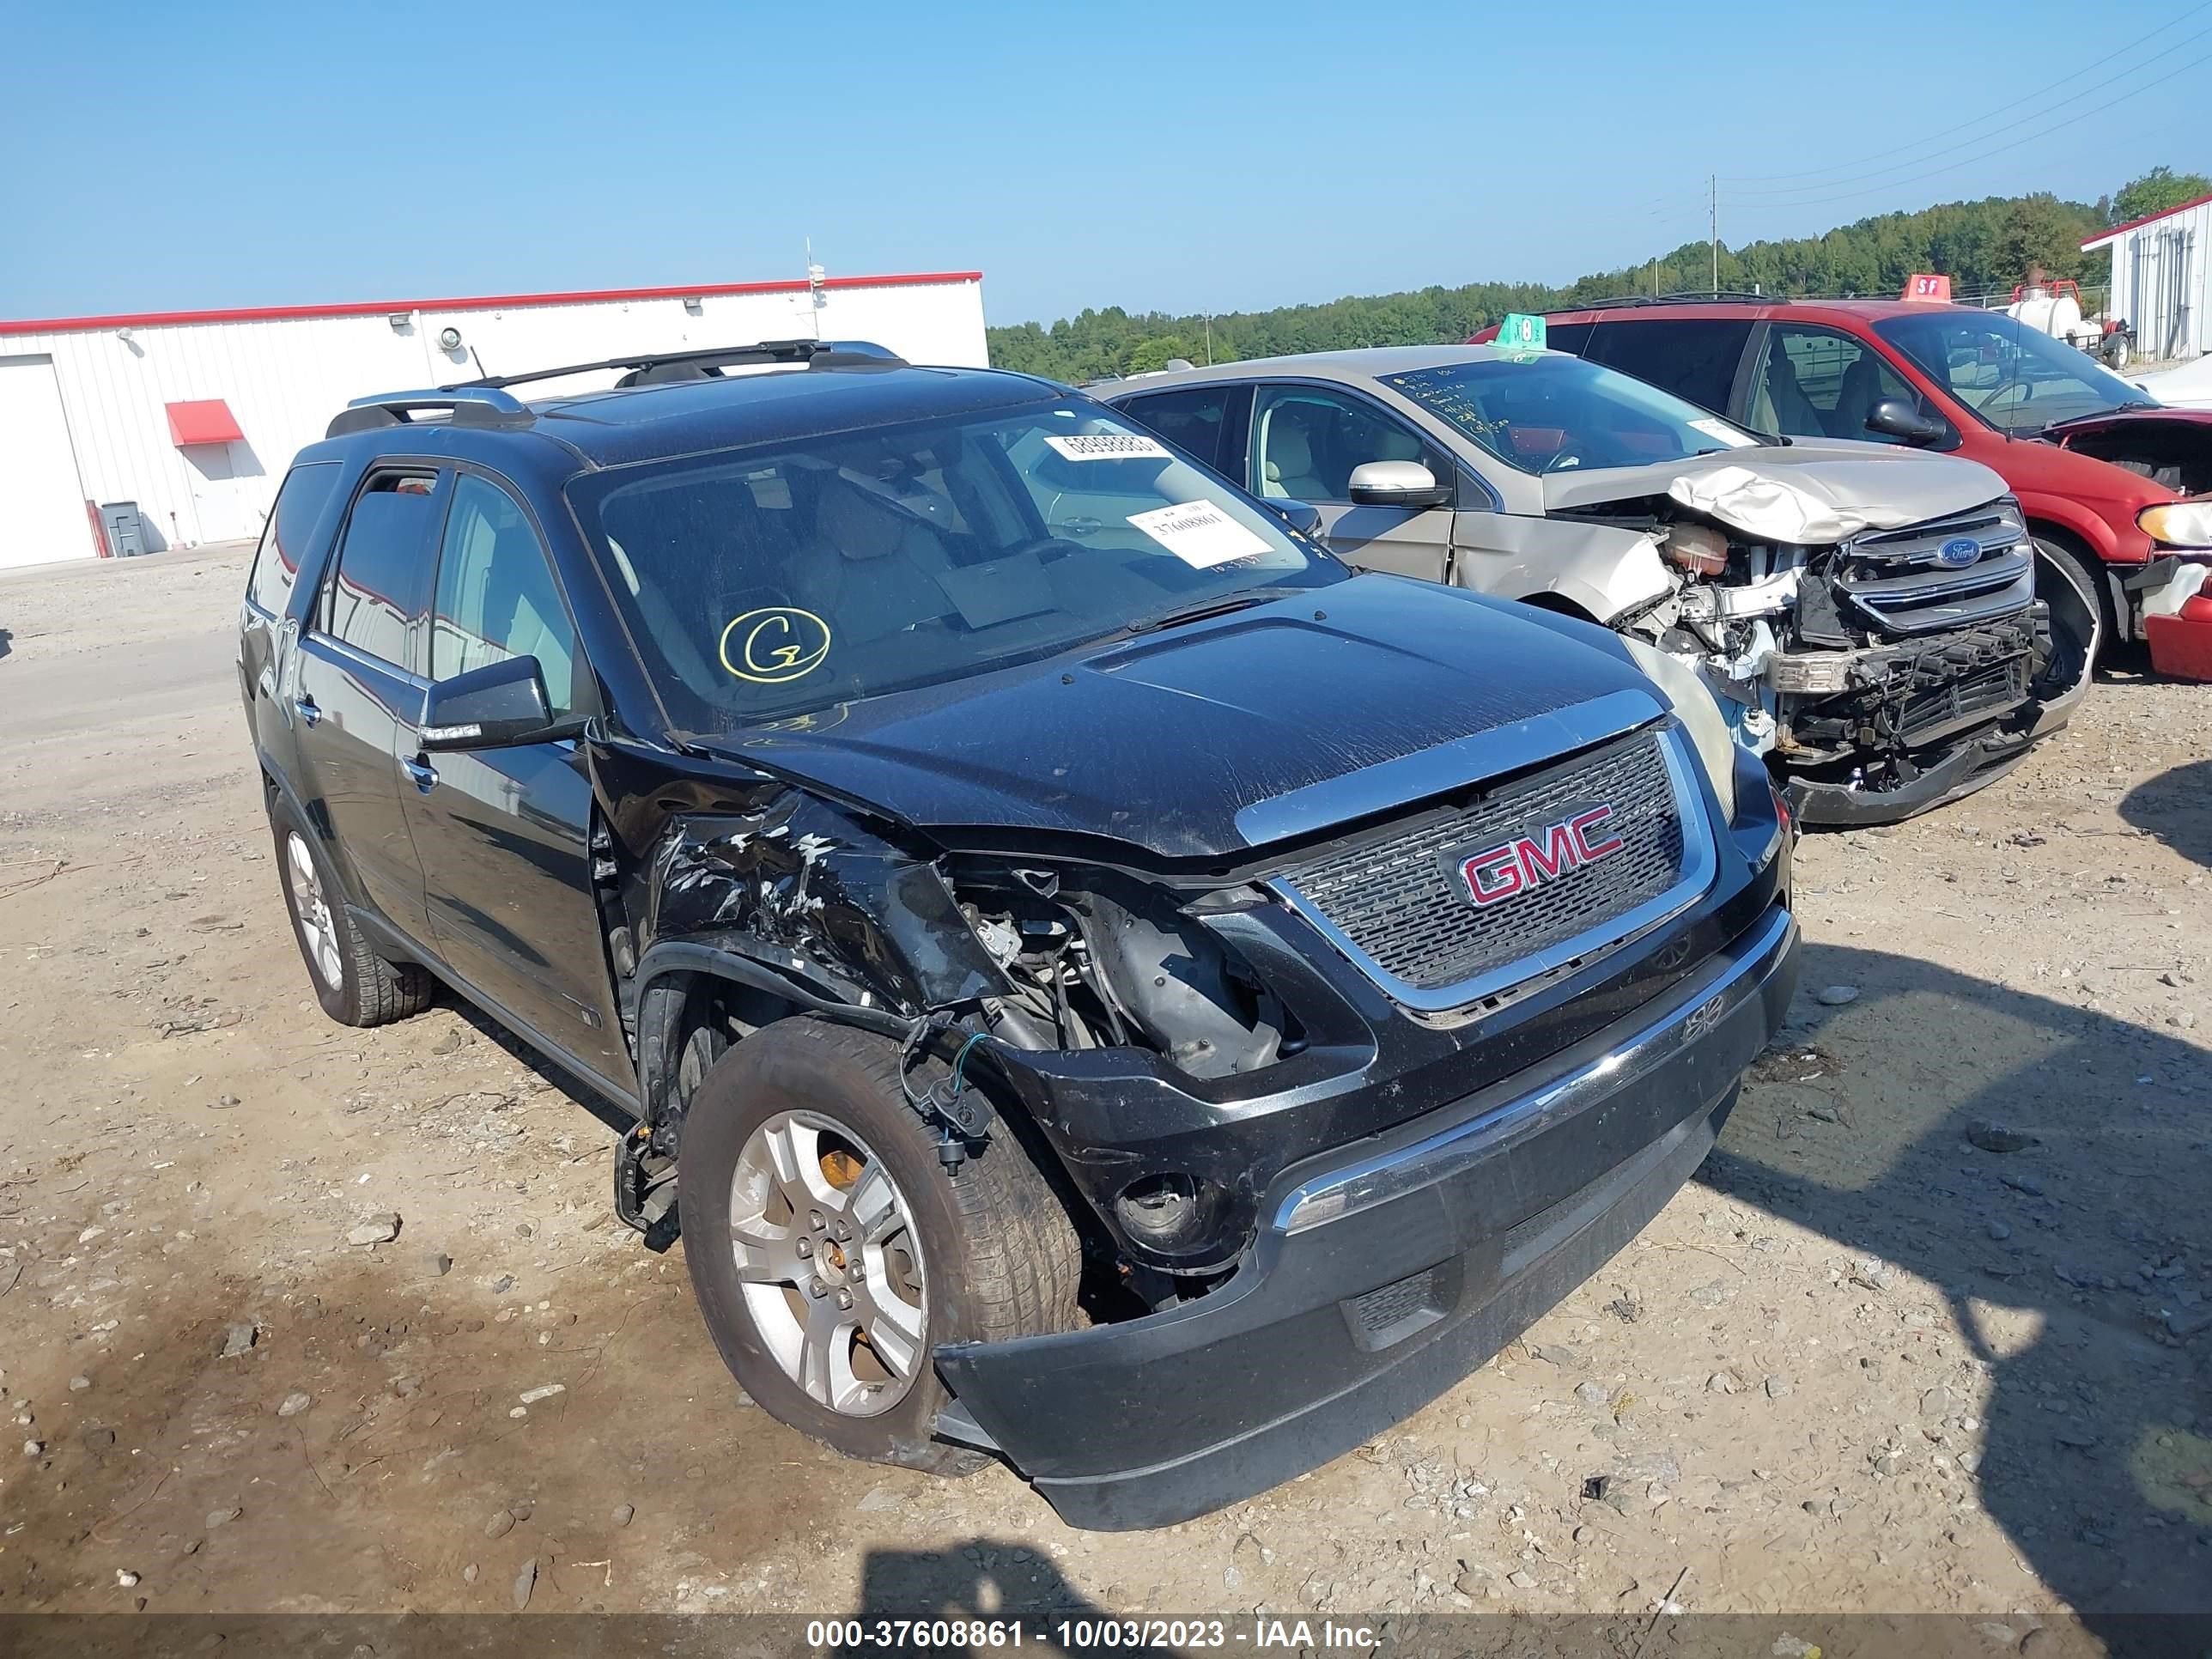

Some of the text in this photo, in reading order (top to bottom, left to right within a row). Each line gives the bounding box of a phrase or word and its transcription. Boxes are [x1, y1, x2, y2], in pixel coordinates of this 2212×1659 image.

[1063, 436, 1153, 453] 68998883
[1153, 514, 1223, 536] 37608861
[1952, 543, 1975, 559] Ford
[1460, 803, 1623, 907] GMC
